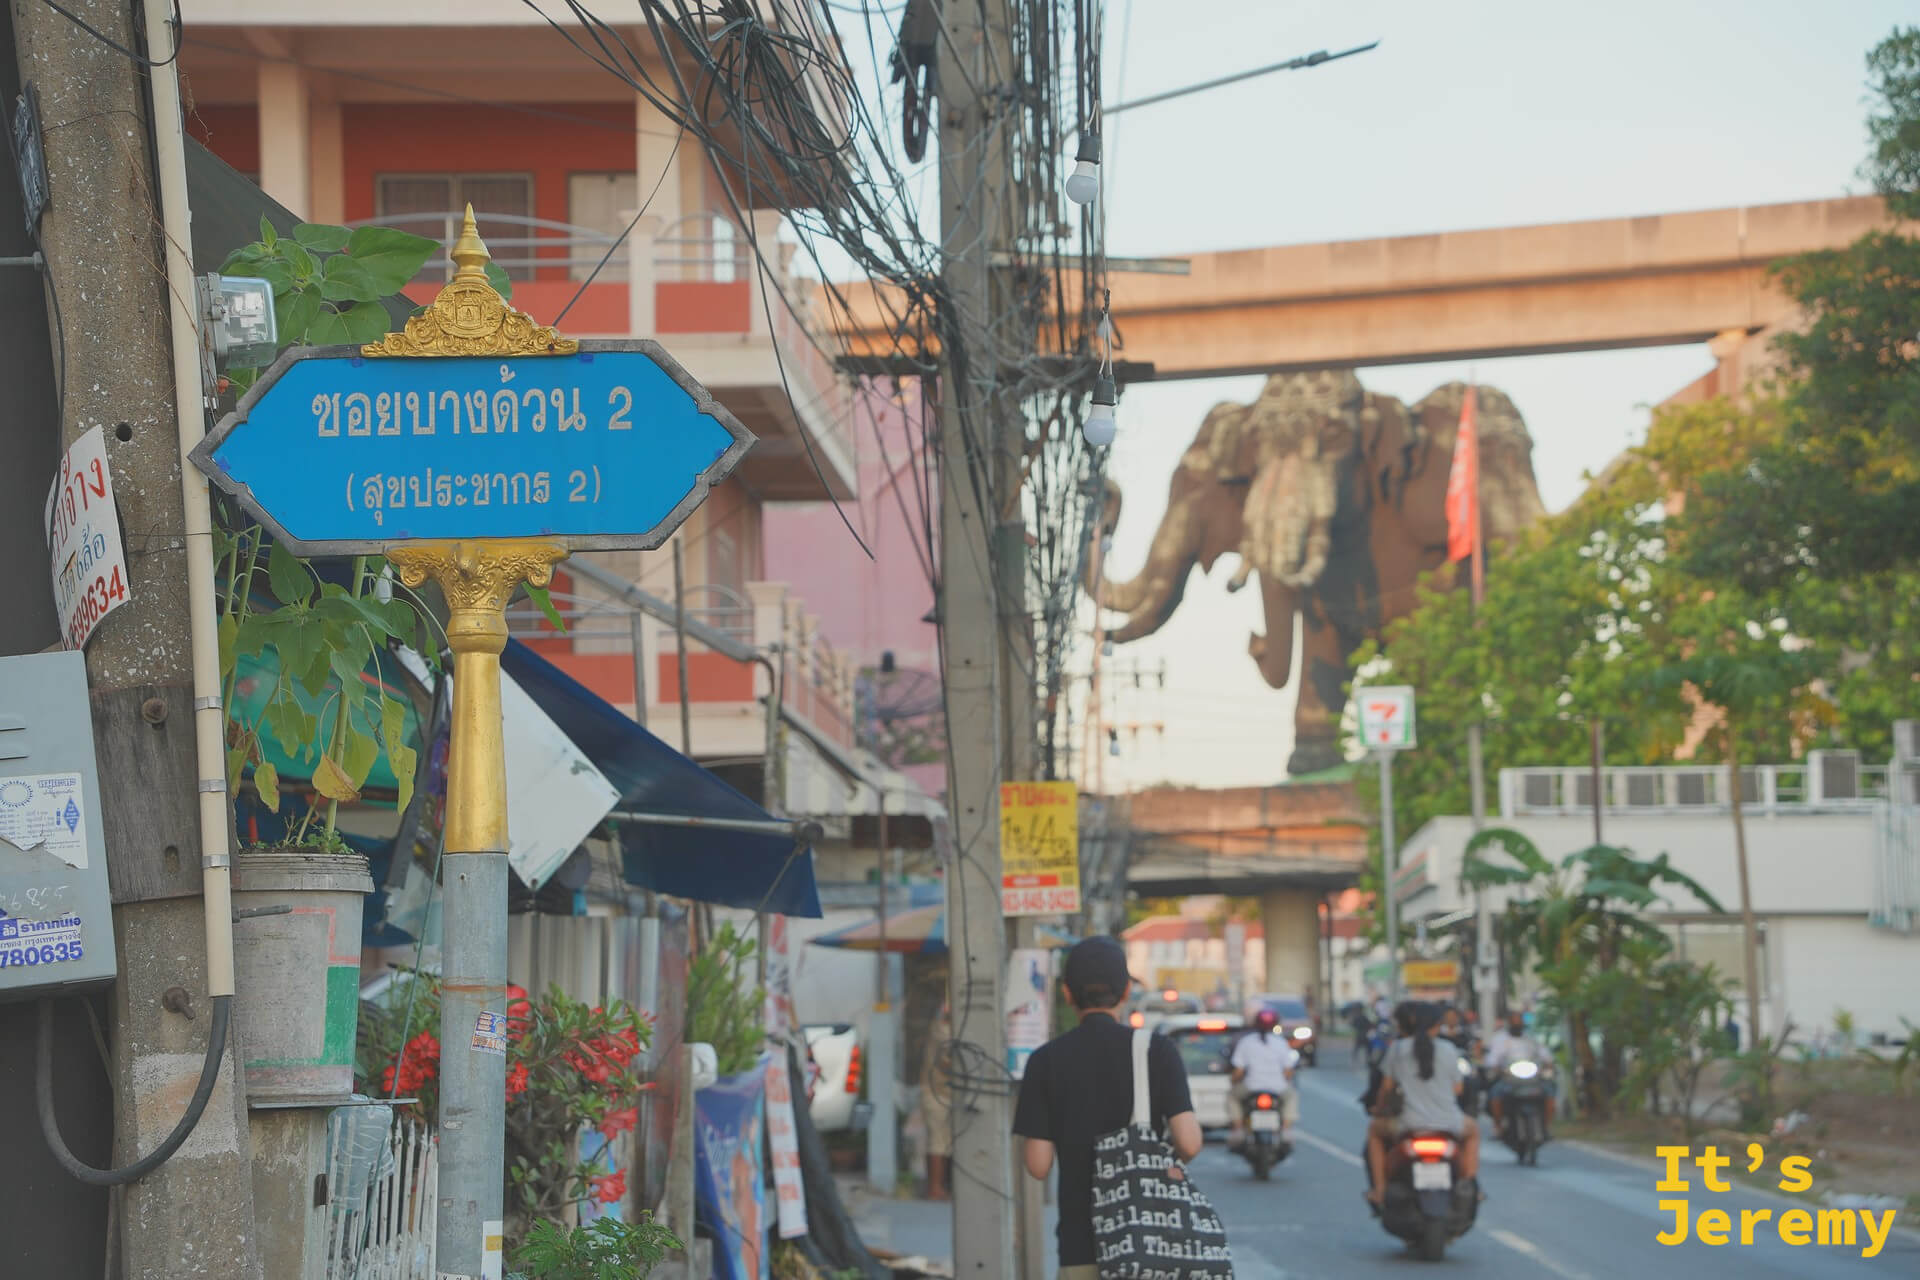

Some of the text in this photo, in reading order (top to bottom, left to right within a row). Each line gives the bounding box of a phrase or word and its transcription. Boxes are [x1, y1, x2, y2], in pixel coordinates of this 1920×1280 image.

[311, 364, 633, 438] ซอยบางด้วน 2
[346, 465, 602, 526] (สุขประชากร 2)
[0, 941, 83, 968] 780635
